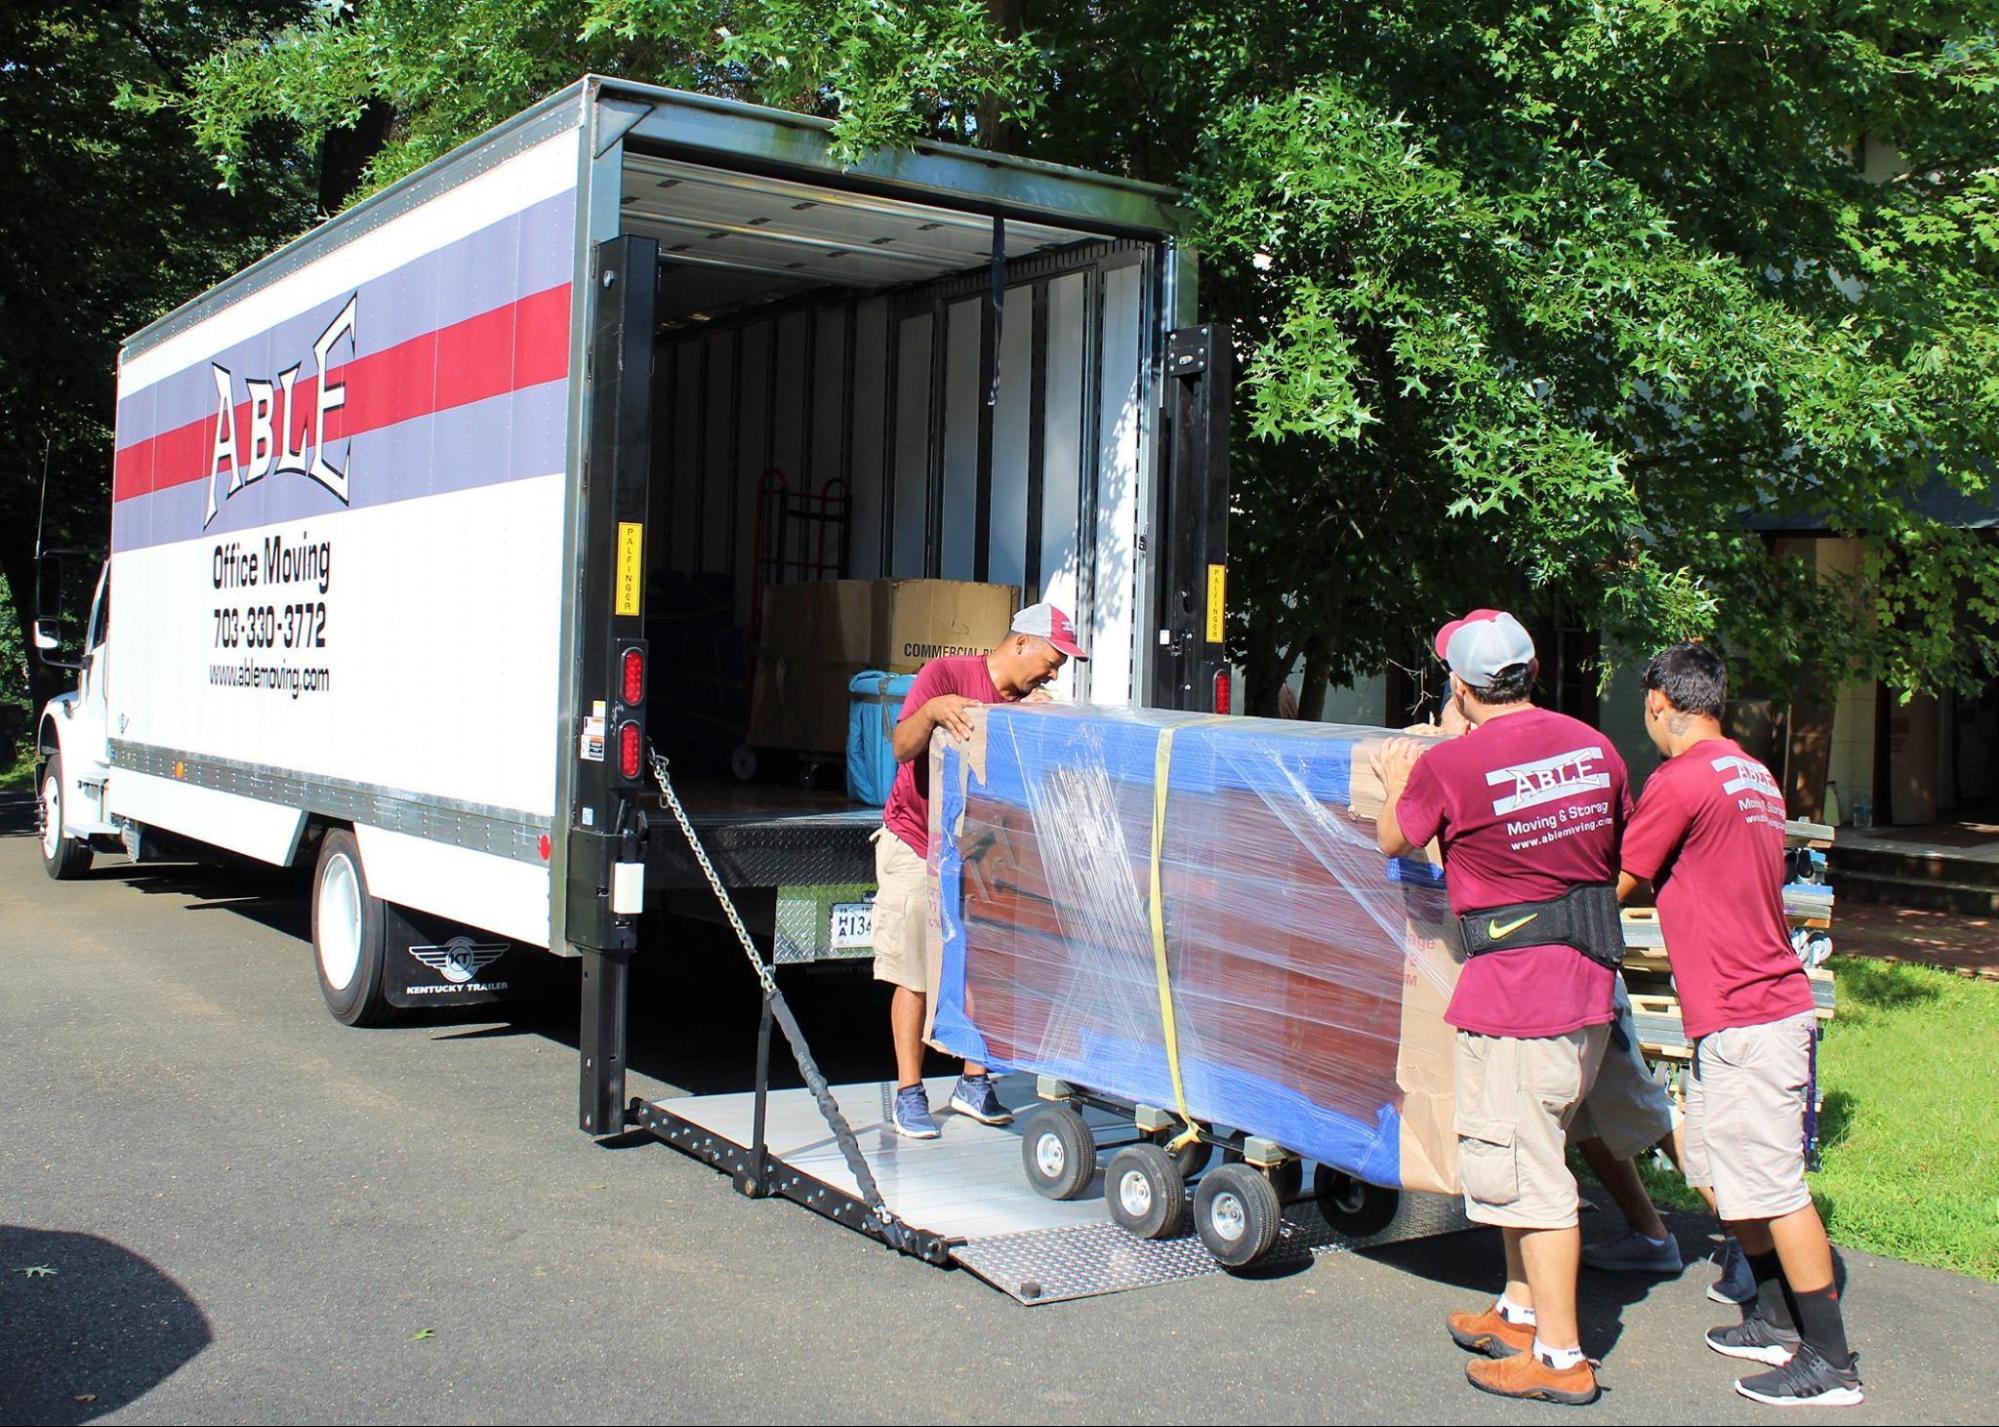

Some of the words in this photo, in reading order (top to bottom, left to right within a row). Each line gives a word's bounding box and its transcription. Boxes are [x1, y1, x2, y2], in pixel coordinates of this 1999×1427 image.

[203, 290, 358, 532] ABLE
[213, 542, 258, 589] Office
[264, 531, 331, 594] Moving
[624, 528, 634, 610] PALFINGER
[214, 602, 326, 648] 703-330-3772
[210, 657, 329, 700] www.ablemoving.com
[1505, 750, 1601, 808] ABLE
[1507, 816, 1557, 836] Moving
[1559, 809, 1567, 822] &
[1568, 802, 1608, 819] Storag
[406, 984, 464, 995] KENTUCKY
[466, 982, 508, 991] TRAILER
